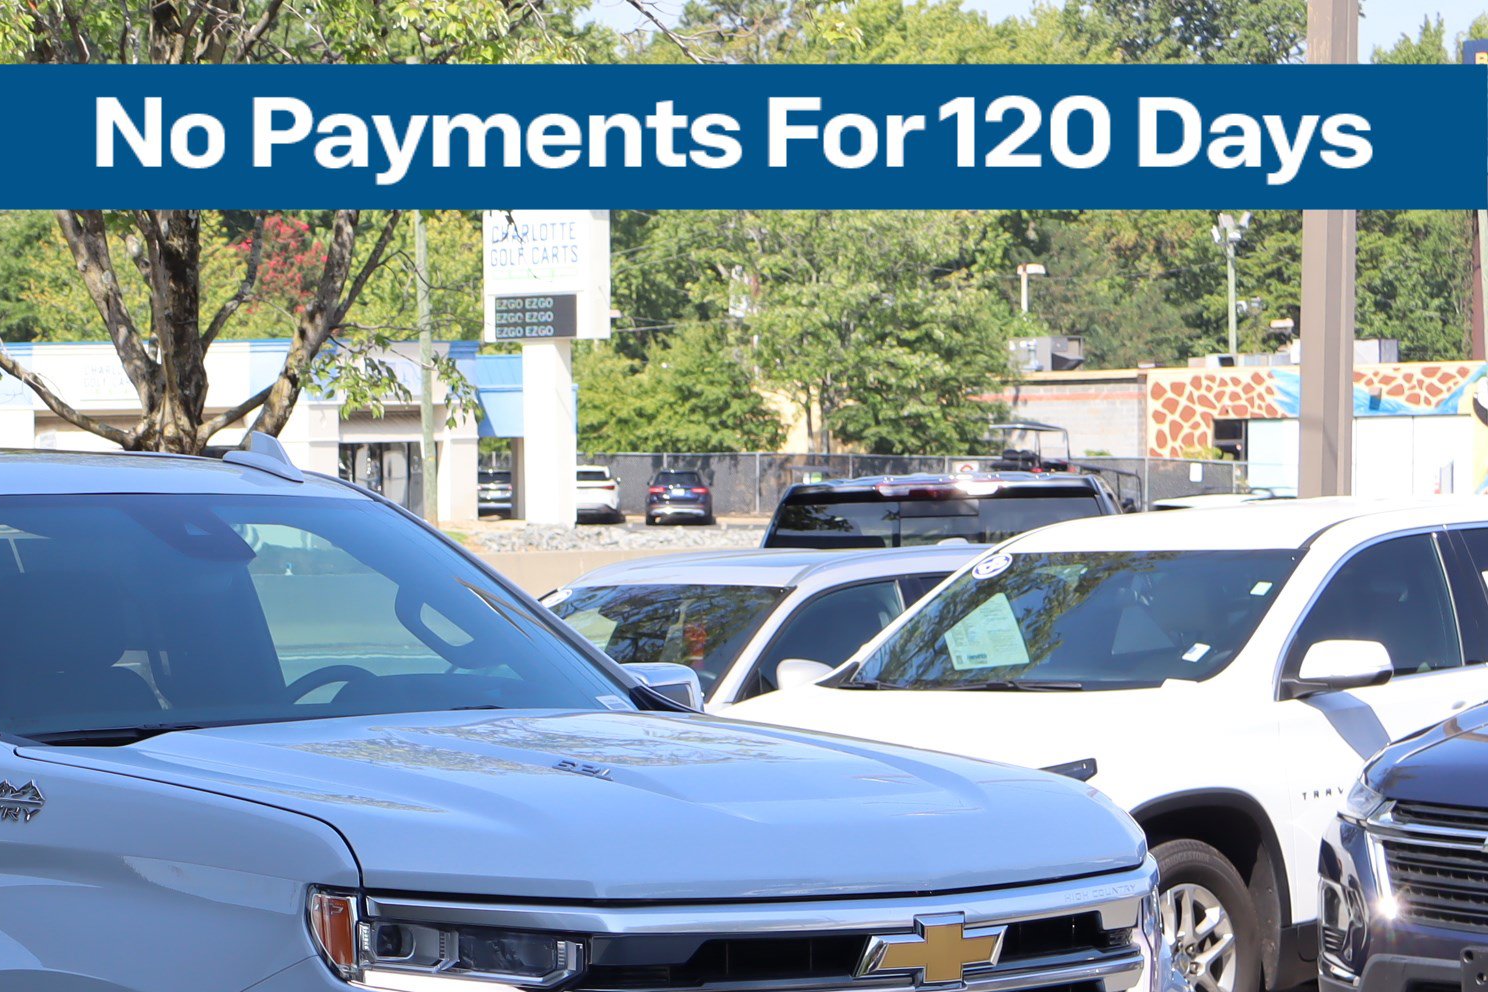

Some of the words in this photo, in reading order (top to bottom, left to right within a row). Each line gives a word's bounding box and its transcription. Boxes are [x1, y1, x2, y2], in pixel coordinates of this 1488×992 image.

[491, 222, 577, 244] CHARLOTTE
[490, 247, 524, 267] GOLF
[531, 245, 578, 265] CARTS
[495, 298, 523, 310] EZGO
[524, 297, 553, 309] EZGO
[495, 312, 524, 324] EZGO
[525, 311, 553, 322] EZGO
[496, 326, 524, 338] EZGO
[525, 325, 554, 337] EZGO
[1302, 786, 1344, 801] TRAV
